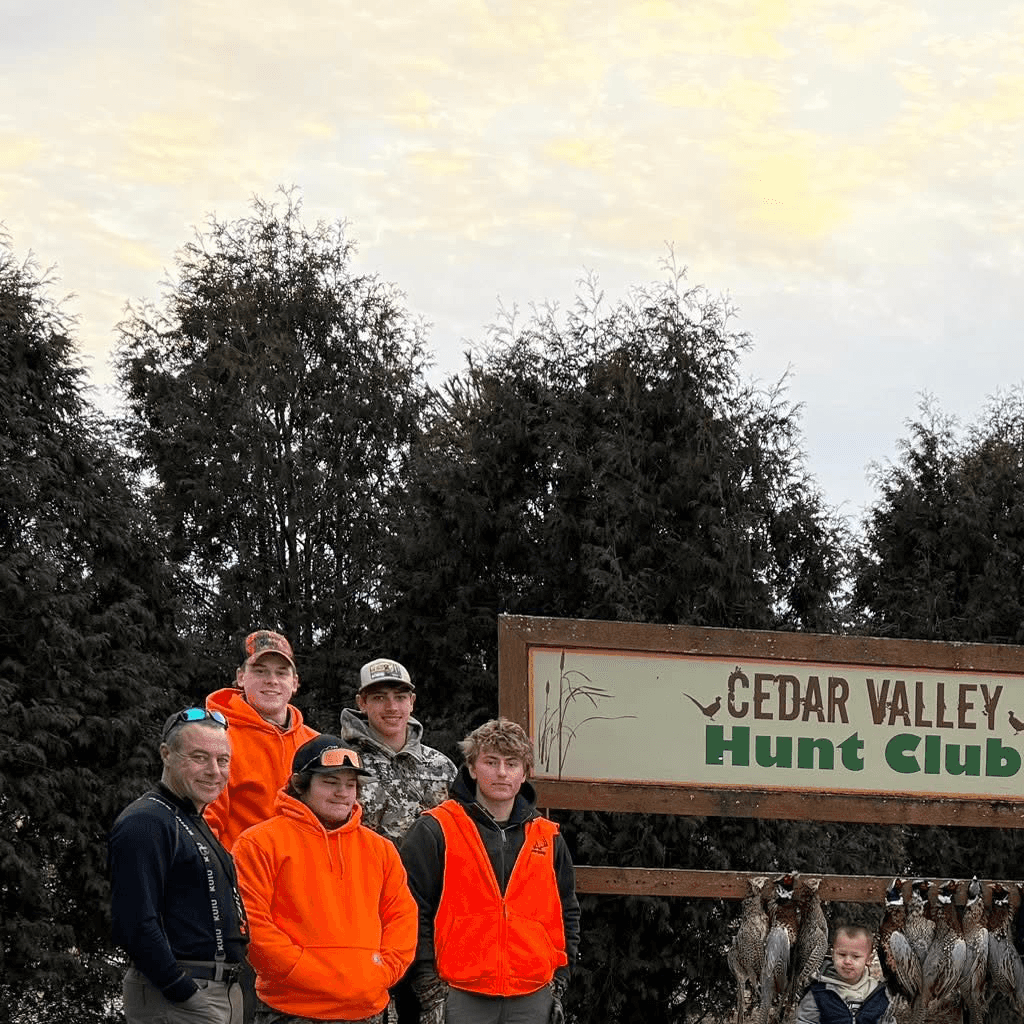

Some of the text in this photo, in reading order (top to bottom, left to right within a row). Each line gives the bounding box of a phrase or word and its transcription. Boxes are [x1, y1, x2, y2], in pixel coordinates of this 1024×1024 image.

[727, 667, 1003, 730] CEDAR VALLEY
[705, 724, 1022, 777] Hunt Club
[207, 869, 216, 892] KUIU
[211, 899, 220, 921] KUIU
[216, 928, 224, 951] KUIU
